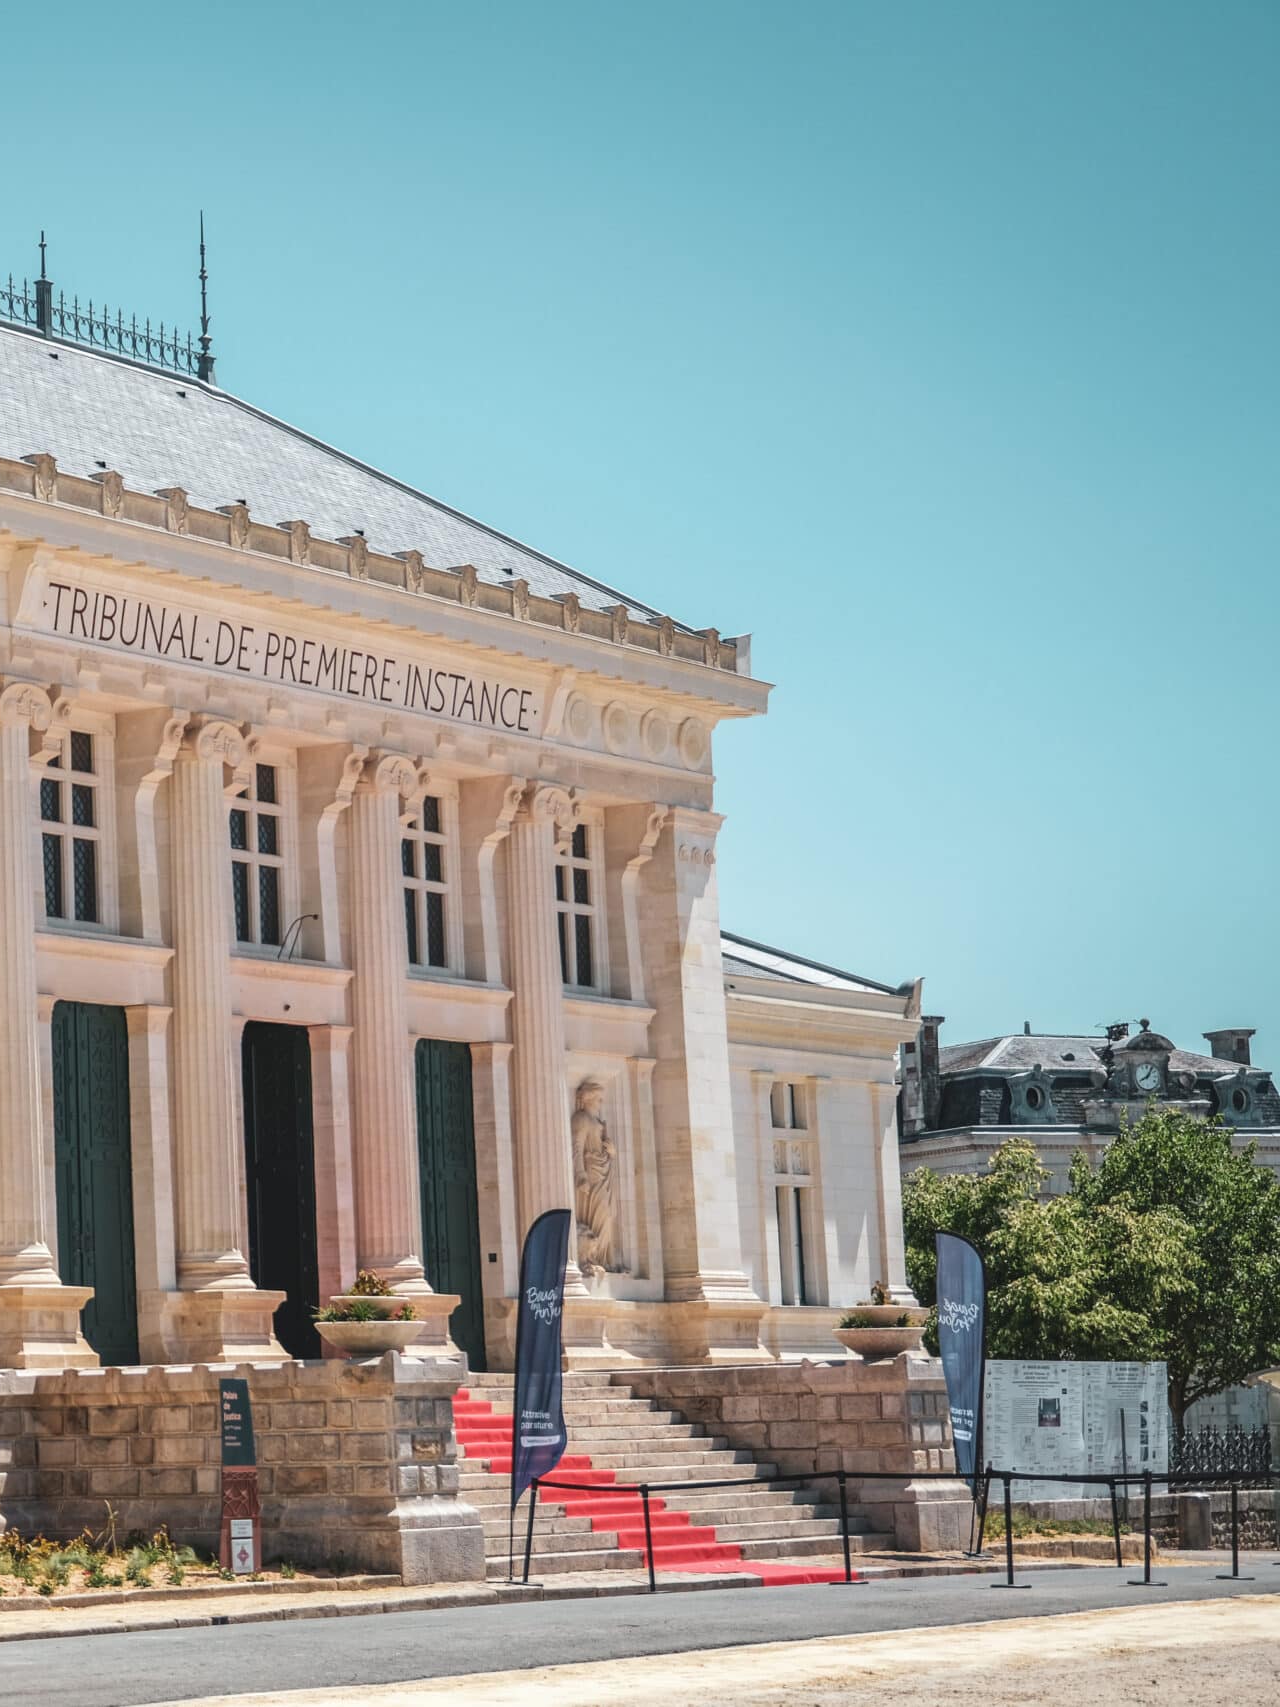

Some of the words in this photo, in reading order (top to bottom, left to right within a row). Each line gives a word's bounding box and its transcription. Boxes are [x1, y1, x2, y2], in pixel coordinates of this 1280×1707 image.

[49, 582, 204, 662] TRIBUNAL
[214, 620, 255, 672] DE
[263, 632, 396, 702] PREMIERE
[403, 663, 533, 732] INSTANCE
